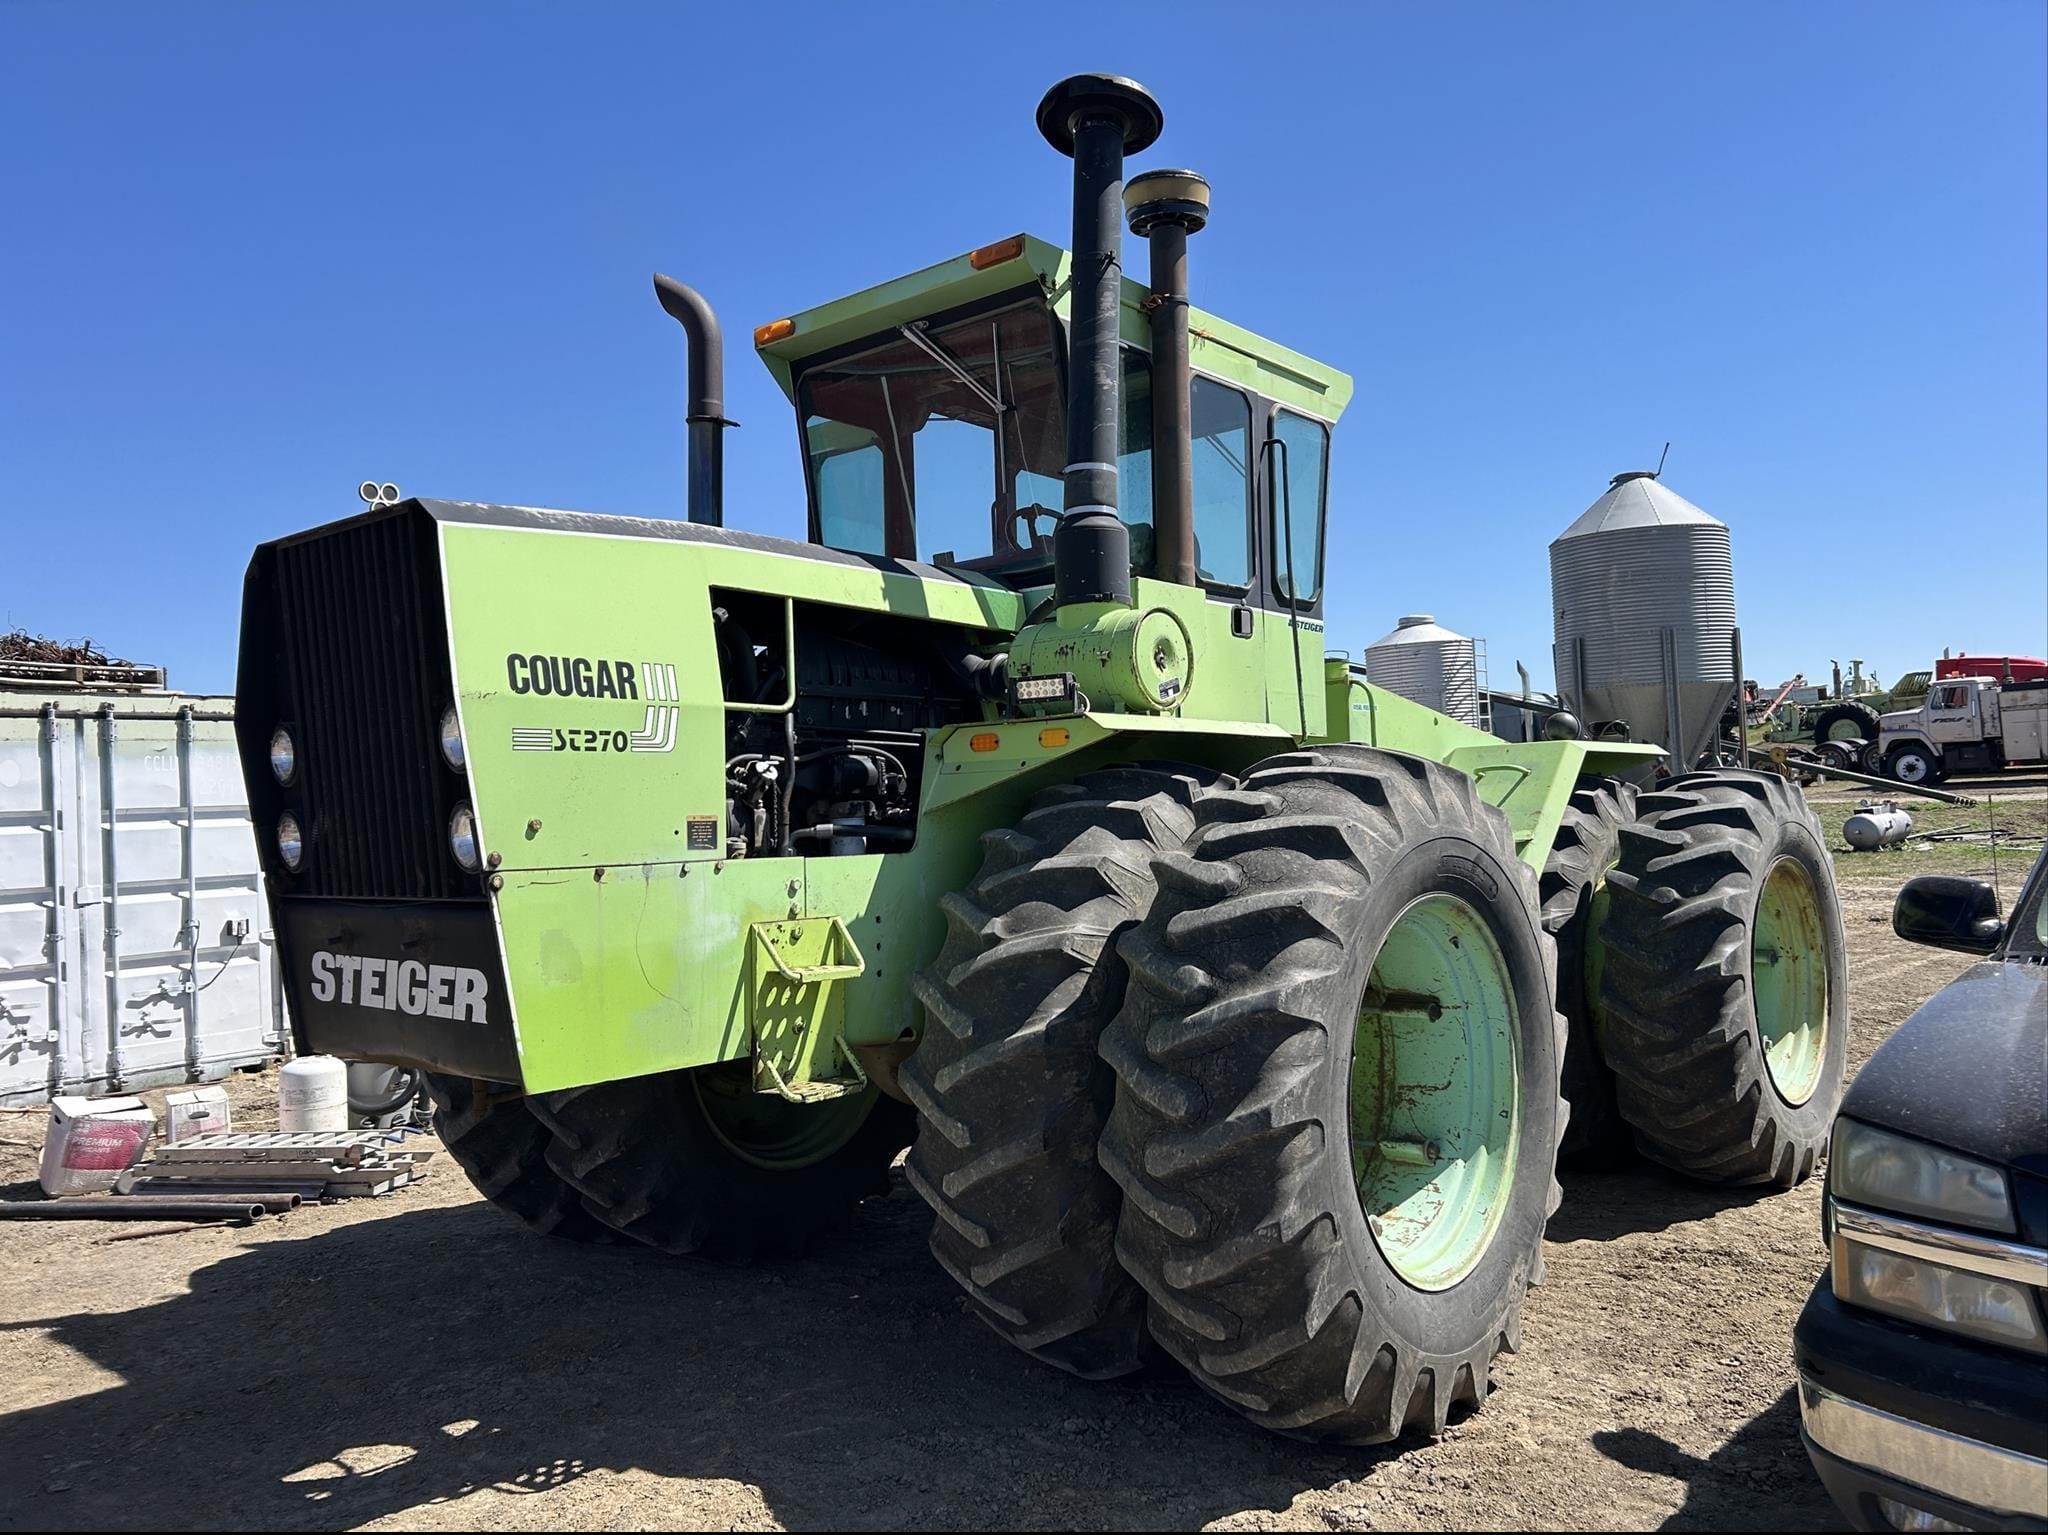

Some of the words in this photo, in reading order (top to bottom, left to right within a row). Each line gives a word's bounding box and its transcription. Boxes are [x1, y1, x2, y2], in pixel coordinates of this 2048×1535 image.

[1295, 620, 1324, 633] STEIGER
[506, 653, 638, 700] COUGAR
[553, 728, 628, 753] ST270
[311, 951, 488, 1025] STEIGER
[72, 1136, 123, 1147] PREMIUM
